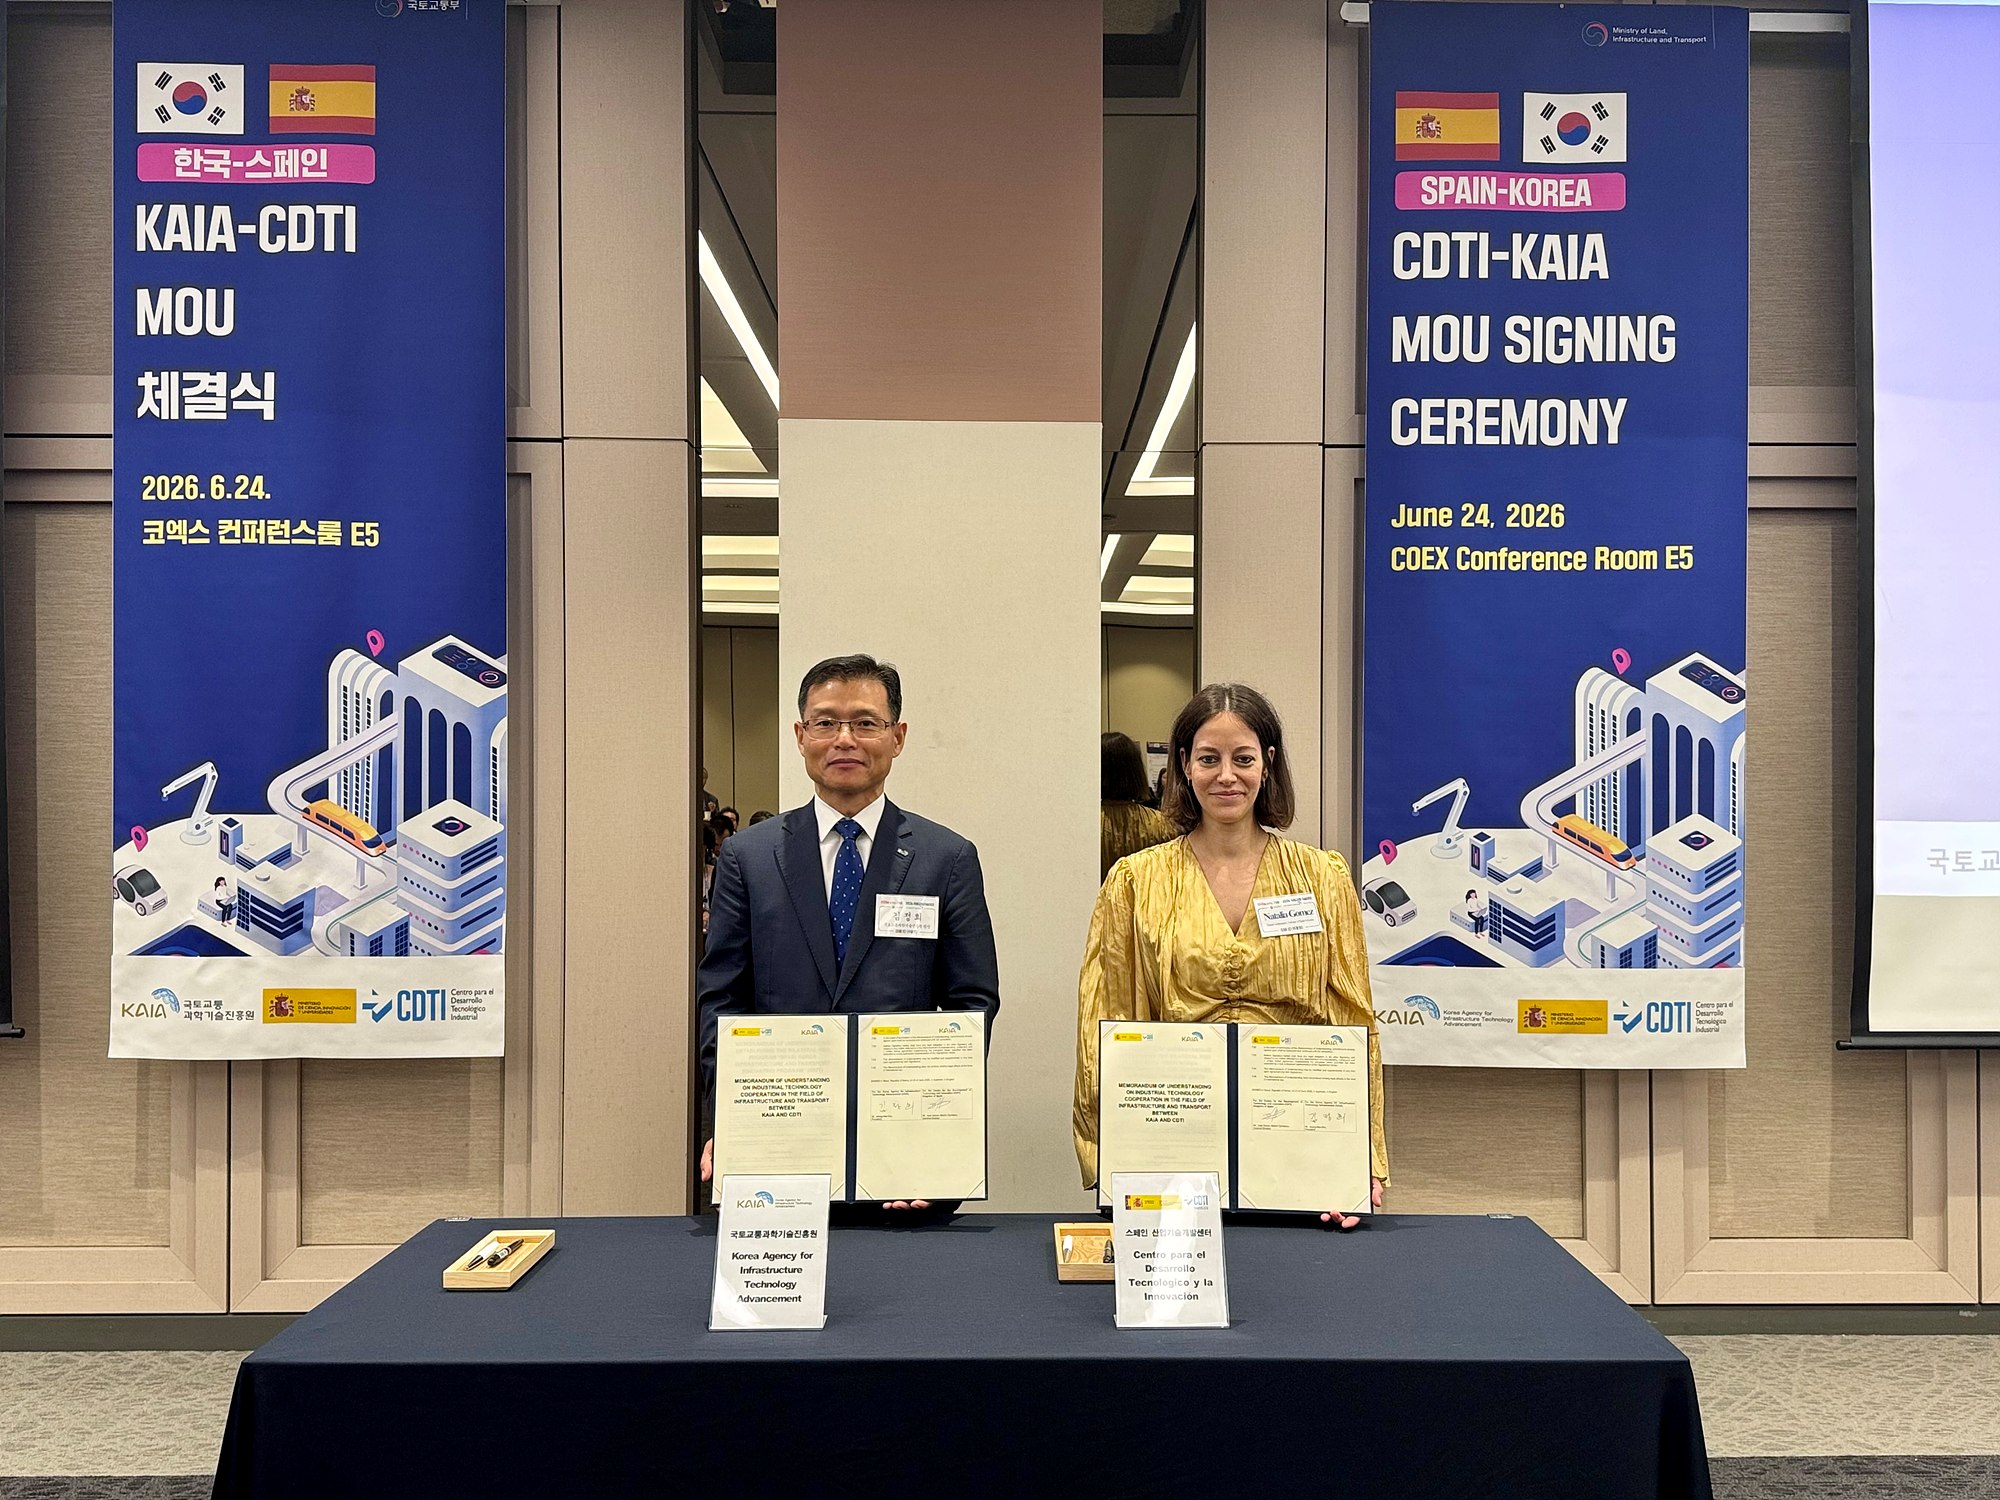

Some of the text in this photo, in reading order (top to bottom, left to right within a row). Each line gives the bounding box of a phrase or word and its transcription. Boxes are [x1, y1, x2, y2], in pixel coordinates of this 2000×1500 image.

[407, 0, 460, 11] 국토교통부
[1612, 27, 1639, 36] Ministry
[1674, 36, 1707, 44] Transport
[173, 148, 328, 179] 한국-스페인
[1420, 176, 1592, 207] SPAIN-KOREA
[136, 204, 357, 253] KAIA-CDTI
[1393, 231, 1609, 280] CDTI-KAIA
[136, 288, 235, 336] MOU
[1391, 314, 1676, 364] MOU SIGNING
[136, 371, 275, 420] 체결식
[1391, 397, 1628, 446] CEREMONY
[1391, 503, 1565, 529] June 24, 2026
[142, 519, 380, 547] 코엑스 컨퍼런스룸 E5
[1391, 545, 1694, 571] COEX Conference Room E5
[1264, 909, 1314, 920] Natalia Gomez
[450, 988, 473, 996] Centro
[183, 1000, 224, 1009] 국토교통
[397, 989, 446, 1022] CDTI
[450, 996, 483, 1004] Desarrollo
[121, 1003, 167, 1019] KAIA
[450, 1005, 486, 1013] Tecnológico
[183, 1010, 255, 1021] 과학기술진흥원
[450, 1013, 478, 1021] Industrial
[1373, 1010, 1425, 1026] KAIA
[1646, 1001, 1691, 1033] CDTI
[736, 1199, 766, 1209] KAIA
[730, 1230, 818, 1239] 국토교통과학기술진흥원
[1125, 1228, 1148, 1237] 스페인
[731, 1251, 814, 1262] Korea Agency for
[1133, 1250, 1206, 1261] Centro para el
[739, 1266, 803, 1274] Infrastructure
[1145, 1264, 1196, 1273] Desarrollo
[743, 1280, 797, 1290] Technology
[1193, 1280, 1200, 1289] y
[1203, 1278, 1213, 1287] la
[736, 1295, 802, 1303] Advancement
[1144, 1292, 1199, 1301] Innovación
